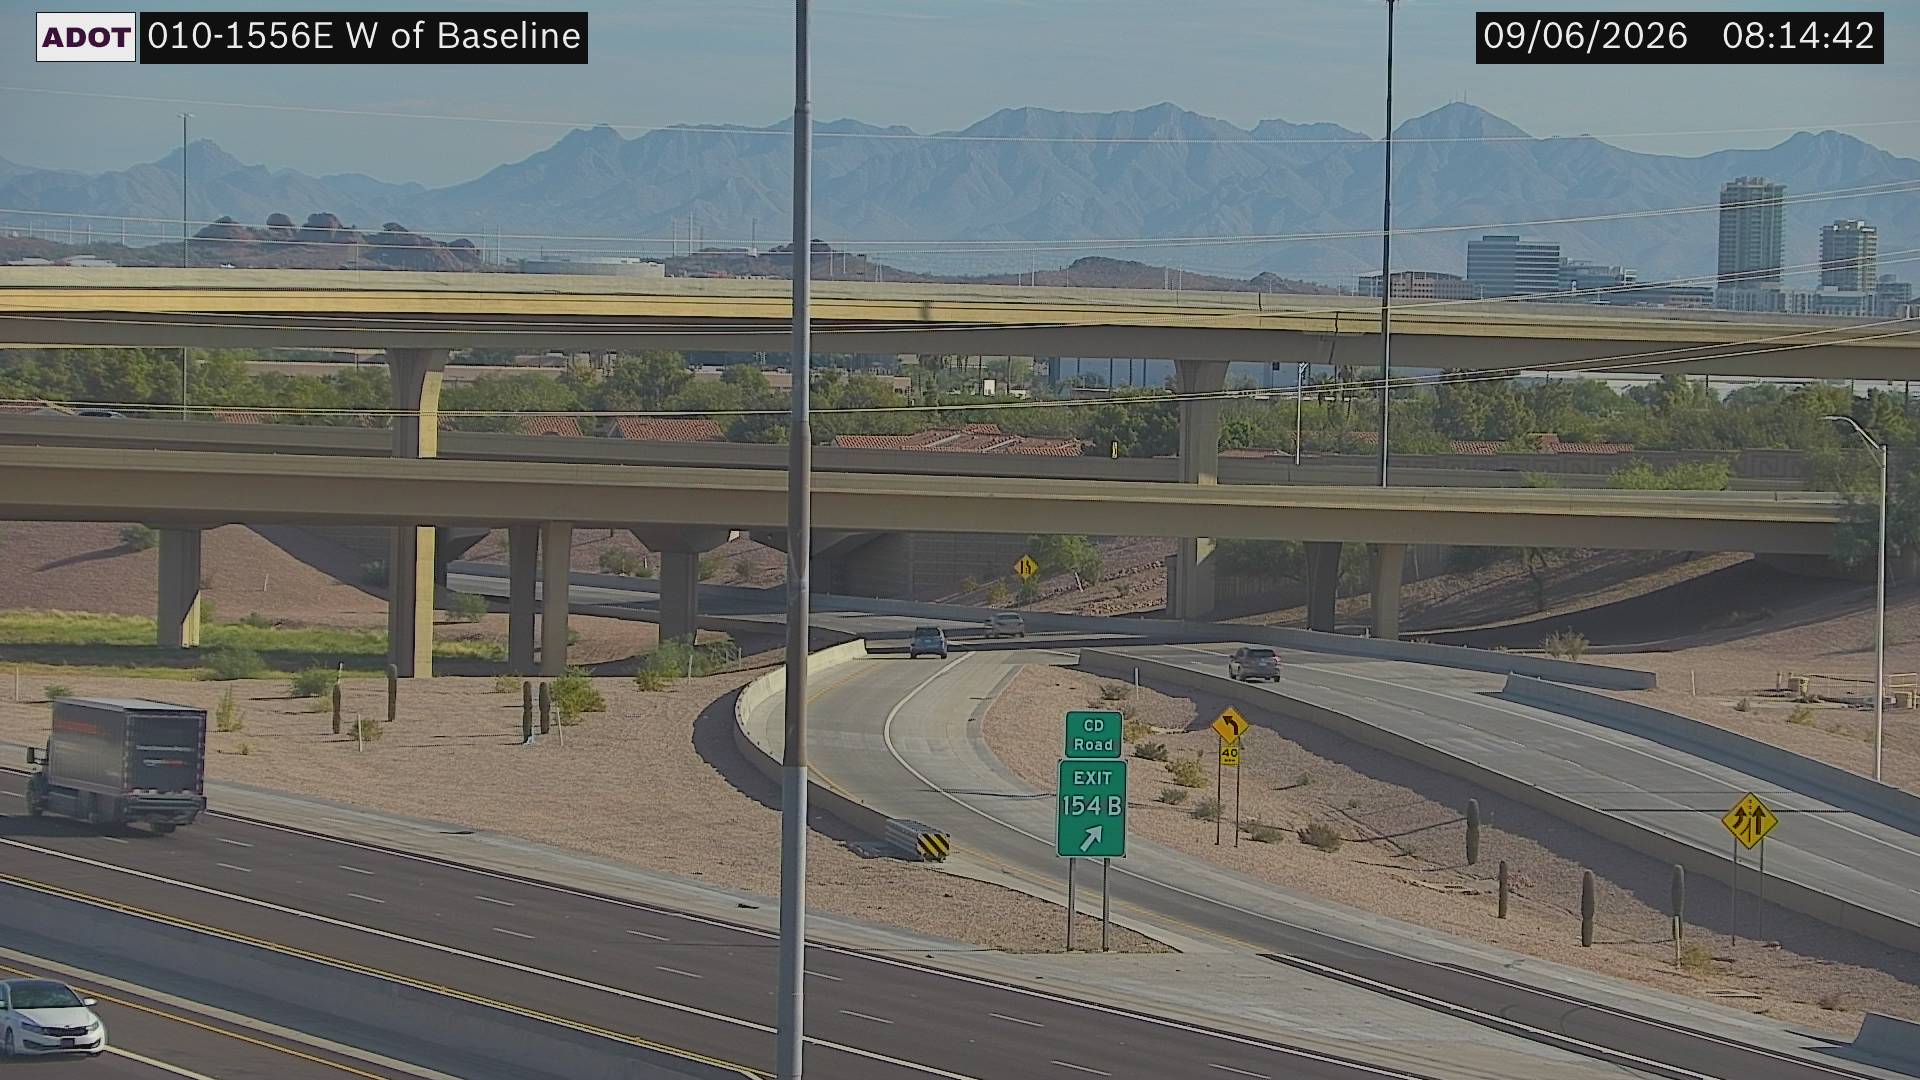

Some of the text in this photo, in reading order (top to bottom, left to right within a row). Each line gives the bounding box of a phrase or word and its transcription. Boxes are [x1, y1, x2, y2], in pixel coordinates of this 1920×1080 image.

[1084, 719, 1104, 732] CD
[1074, 738, 1113, 751] Road
[1221, 748, 1238, 757] 40
[1074, 771, 1113, 785] EXIT
[1063, 795, 1122, 816] 154 B
